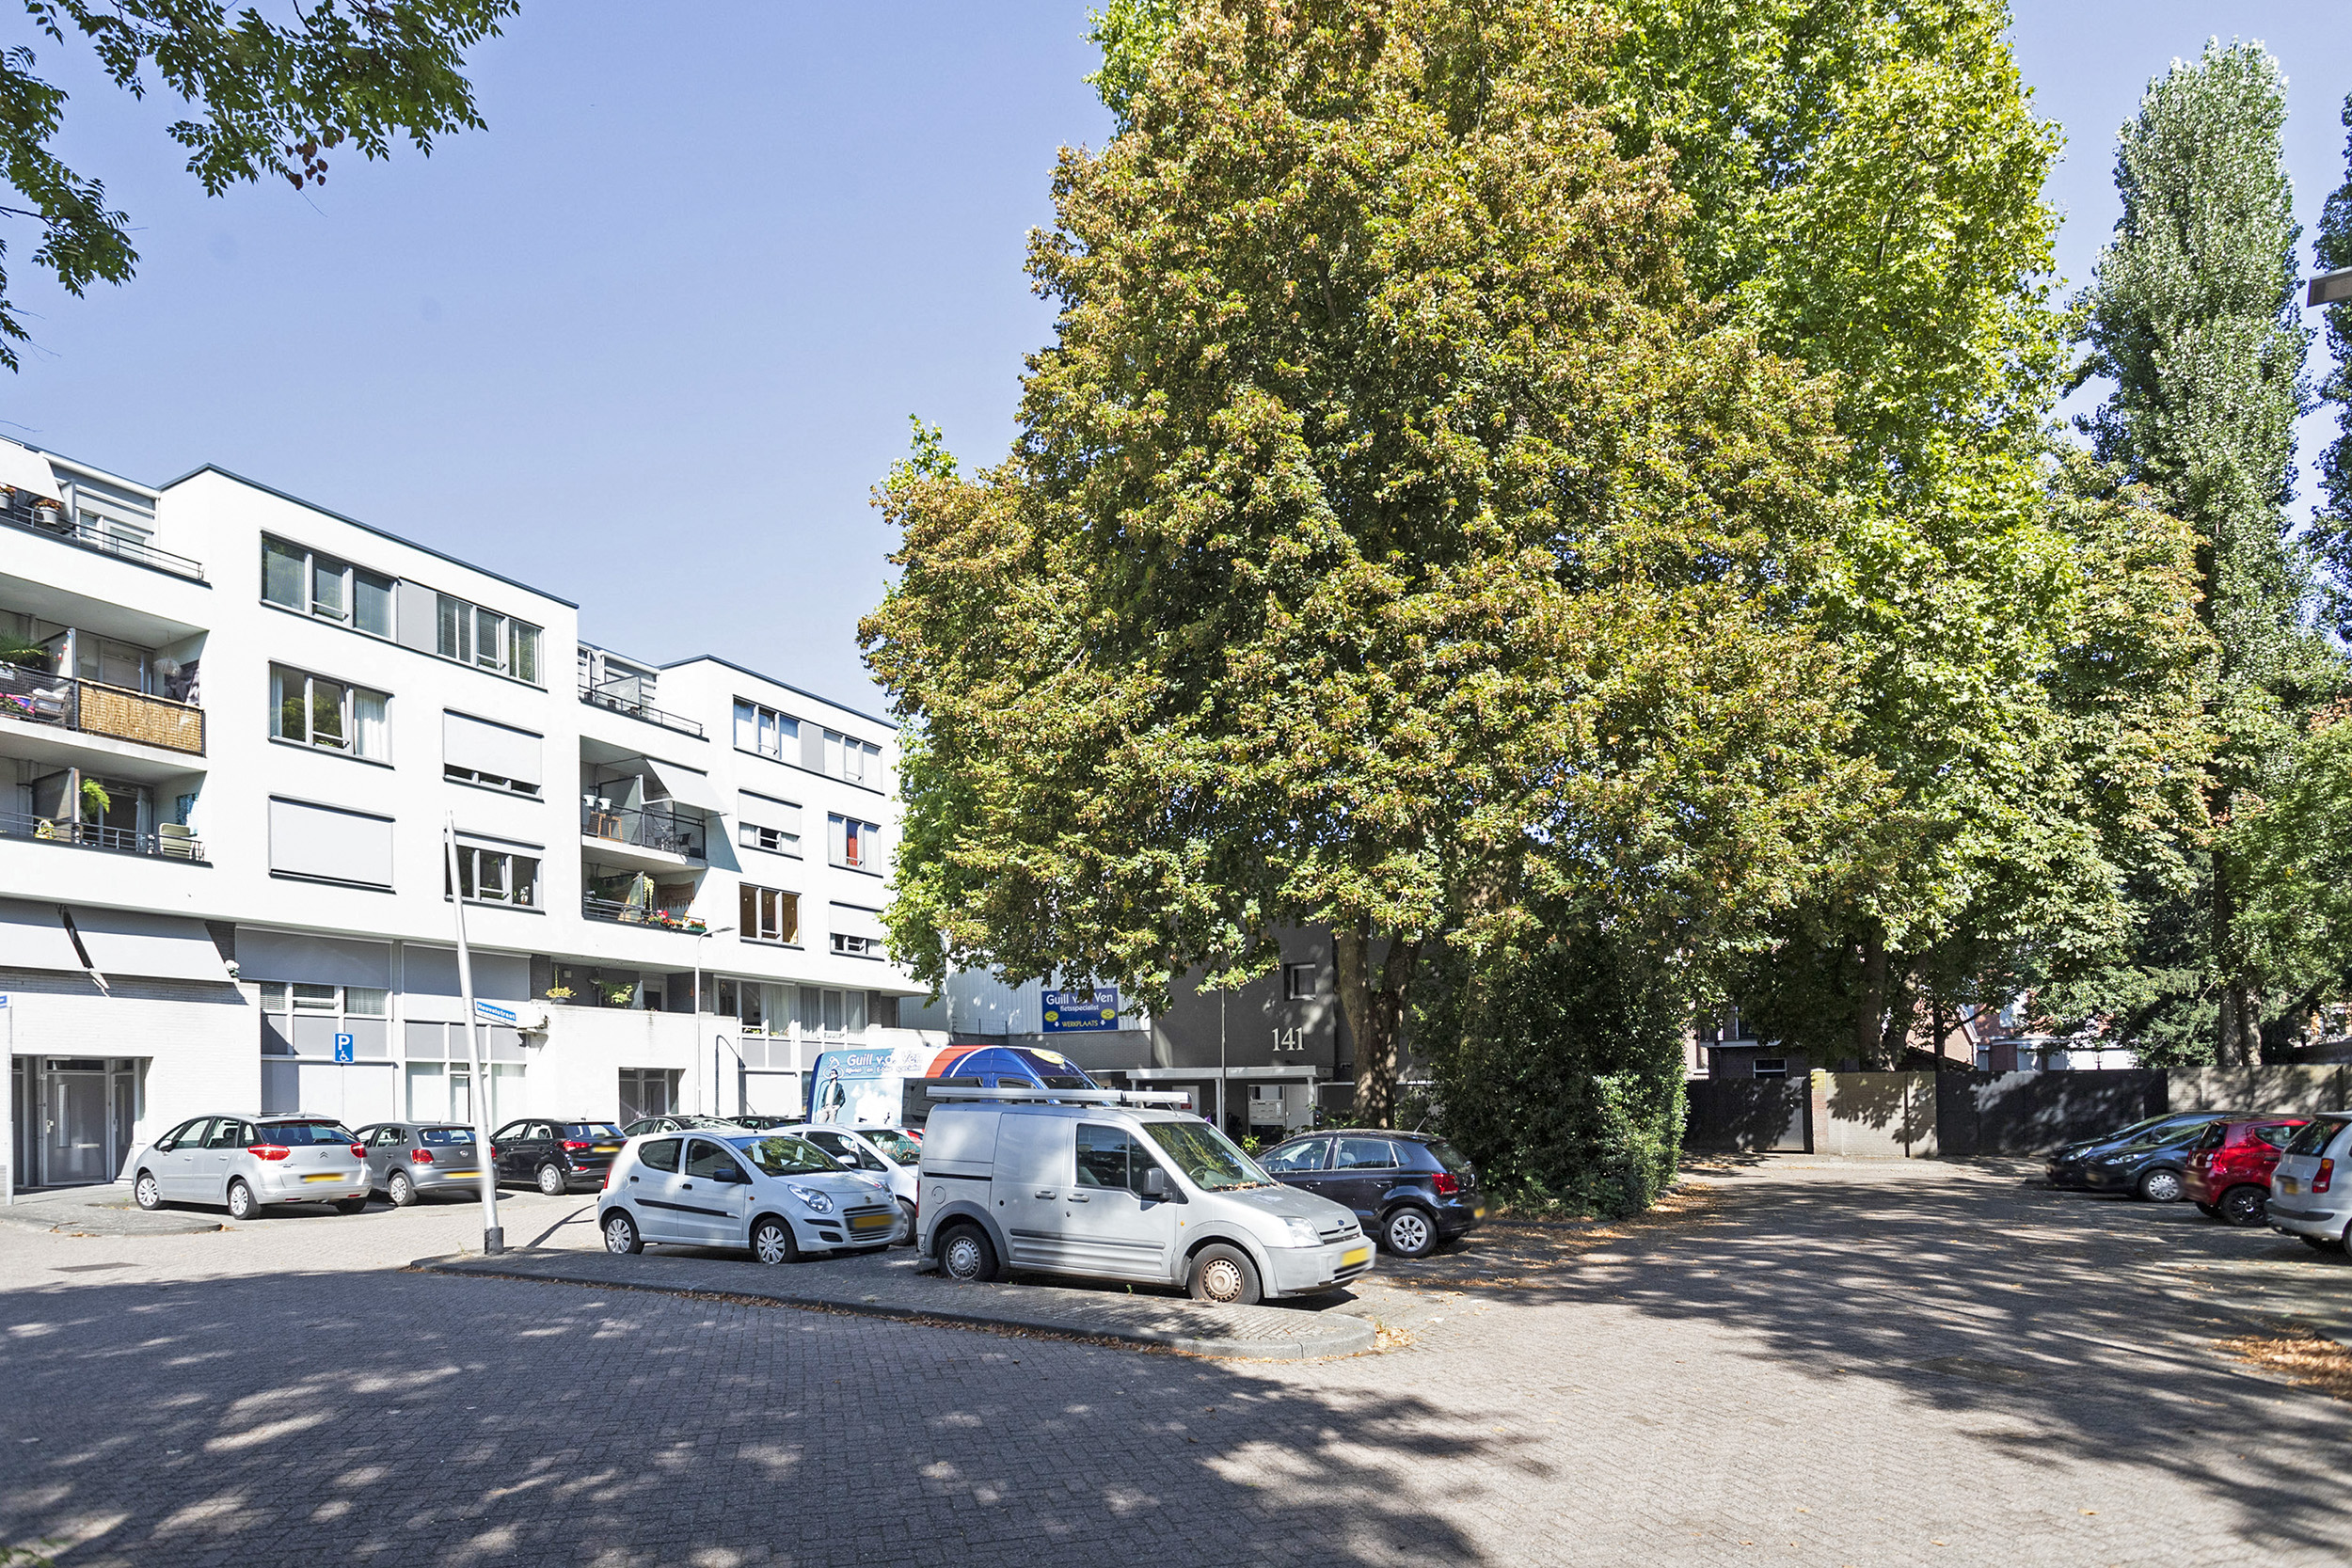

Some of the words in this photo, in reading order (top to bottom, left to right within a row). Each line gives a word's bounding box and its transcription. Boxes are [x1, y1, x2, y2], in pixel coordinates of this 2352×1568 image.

[1046, 993, 1069, 1005] Guill
[1094, 992, 1113, 1003] Ven
[338, 1035, 350, 1051] P
[1272, 1027, 1305, 1051] 141
[847, 1053, 873, 1066] Guill
